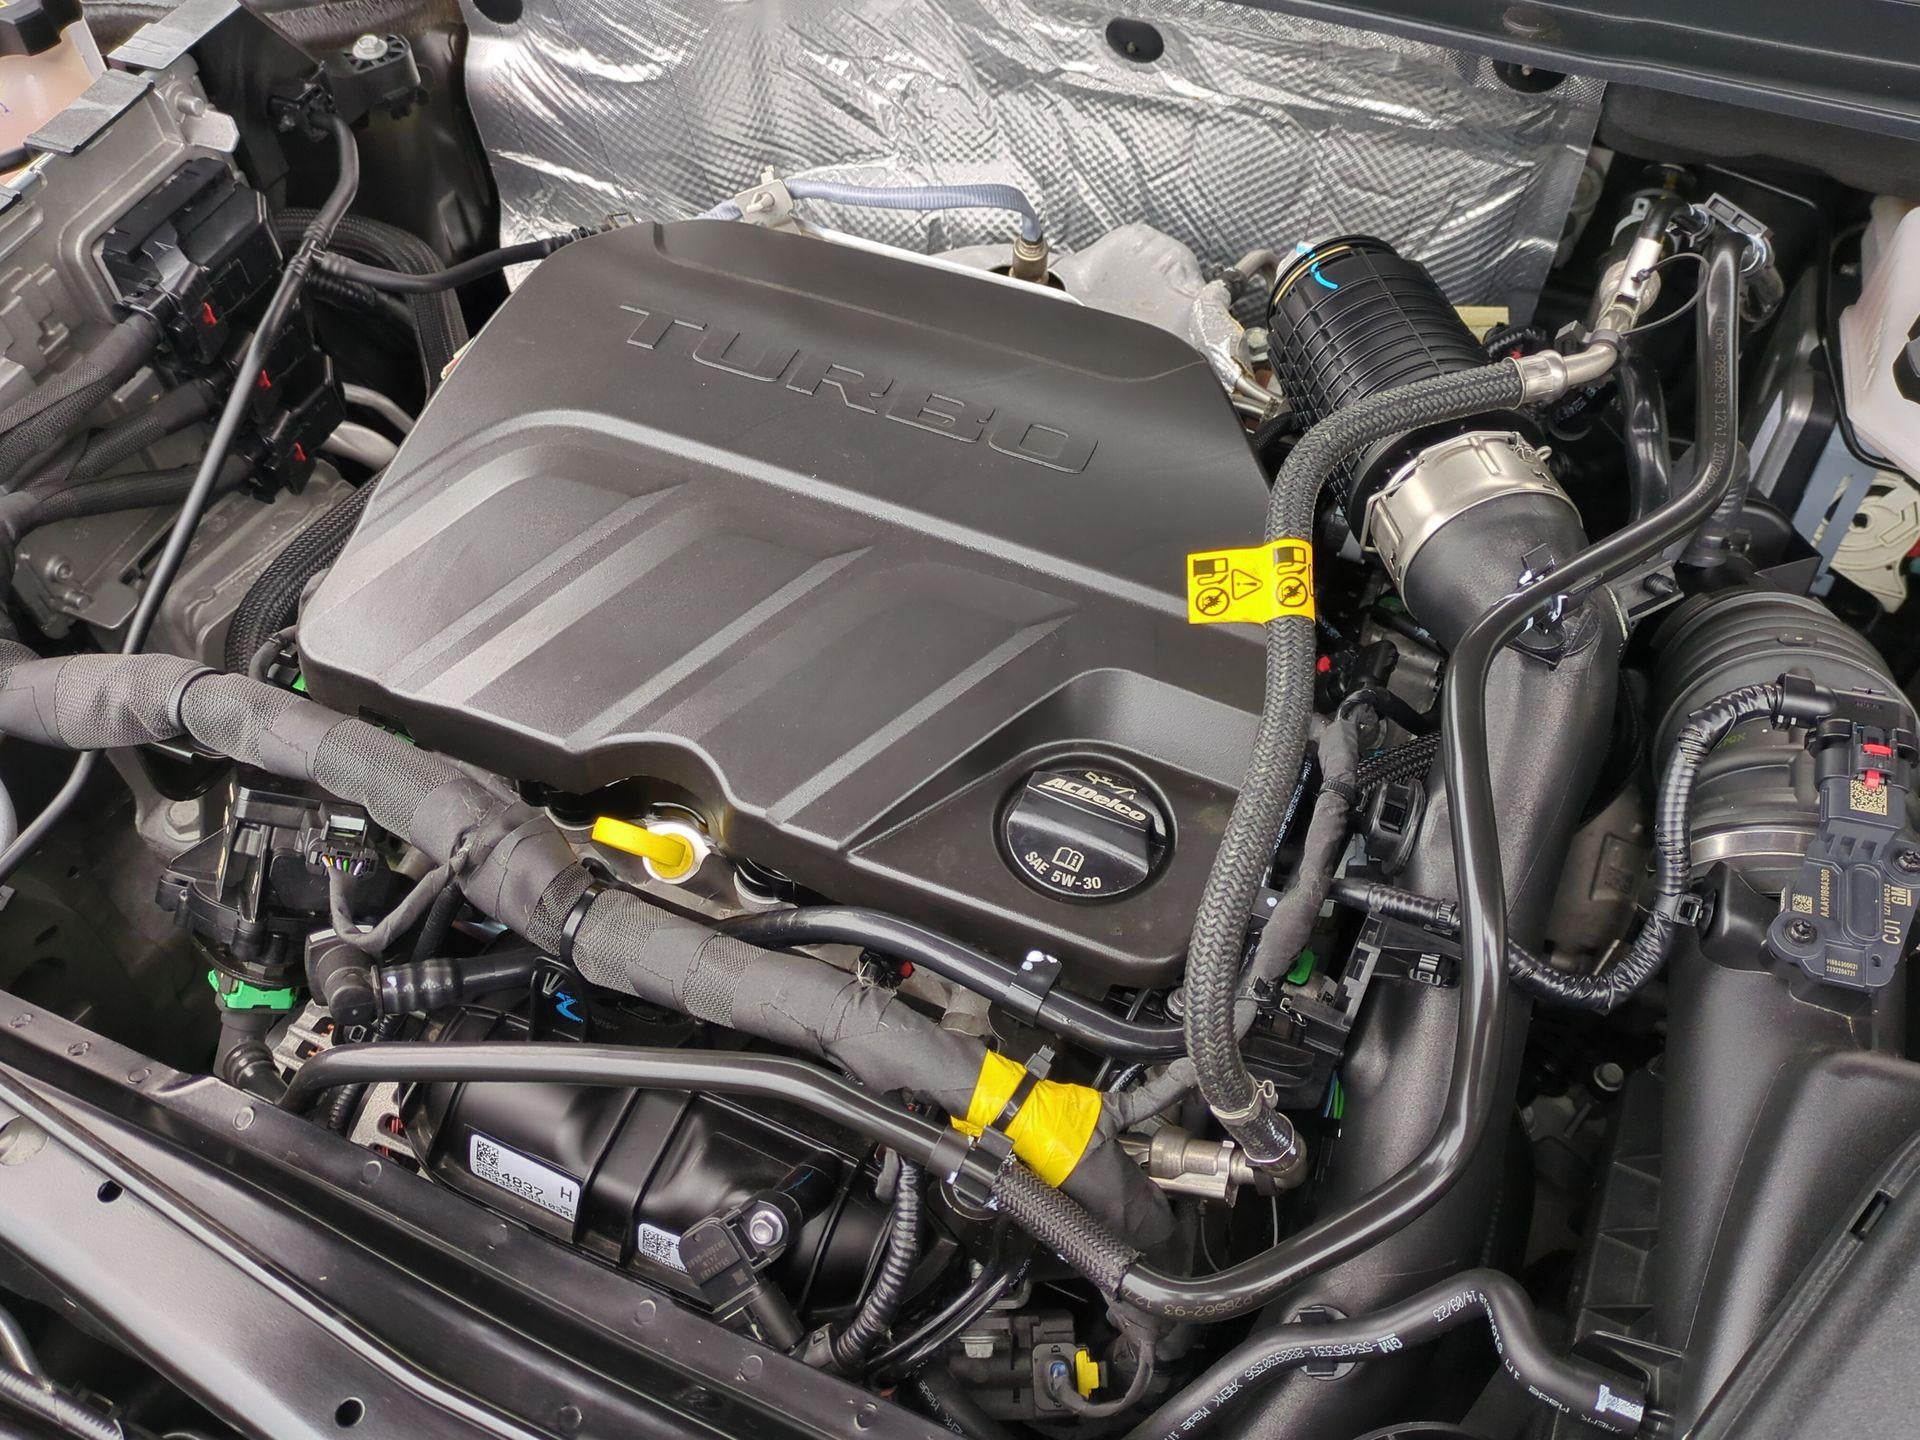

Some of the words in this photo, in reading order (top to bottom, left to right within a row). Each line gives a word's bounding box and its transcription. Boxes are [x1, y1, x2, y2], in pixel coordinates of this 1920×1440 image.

[620, 305, 1099, 474] TURBO
[1039, 777, 1146, 823] ACDelco
[1025, 851, 1050, 875] SAE
[1051, 871, 1102, 890] 5W-30
[1891, 887, 1910, 907] GM
[560, 1186, 573, 1202] H
[1432, 1289, 1478, 1322] 14/09/23
[1179, 1404, 1211, 1434] Made
